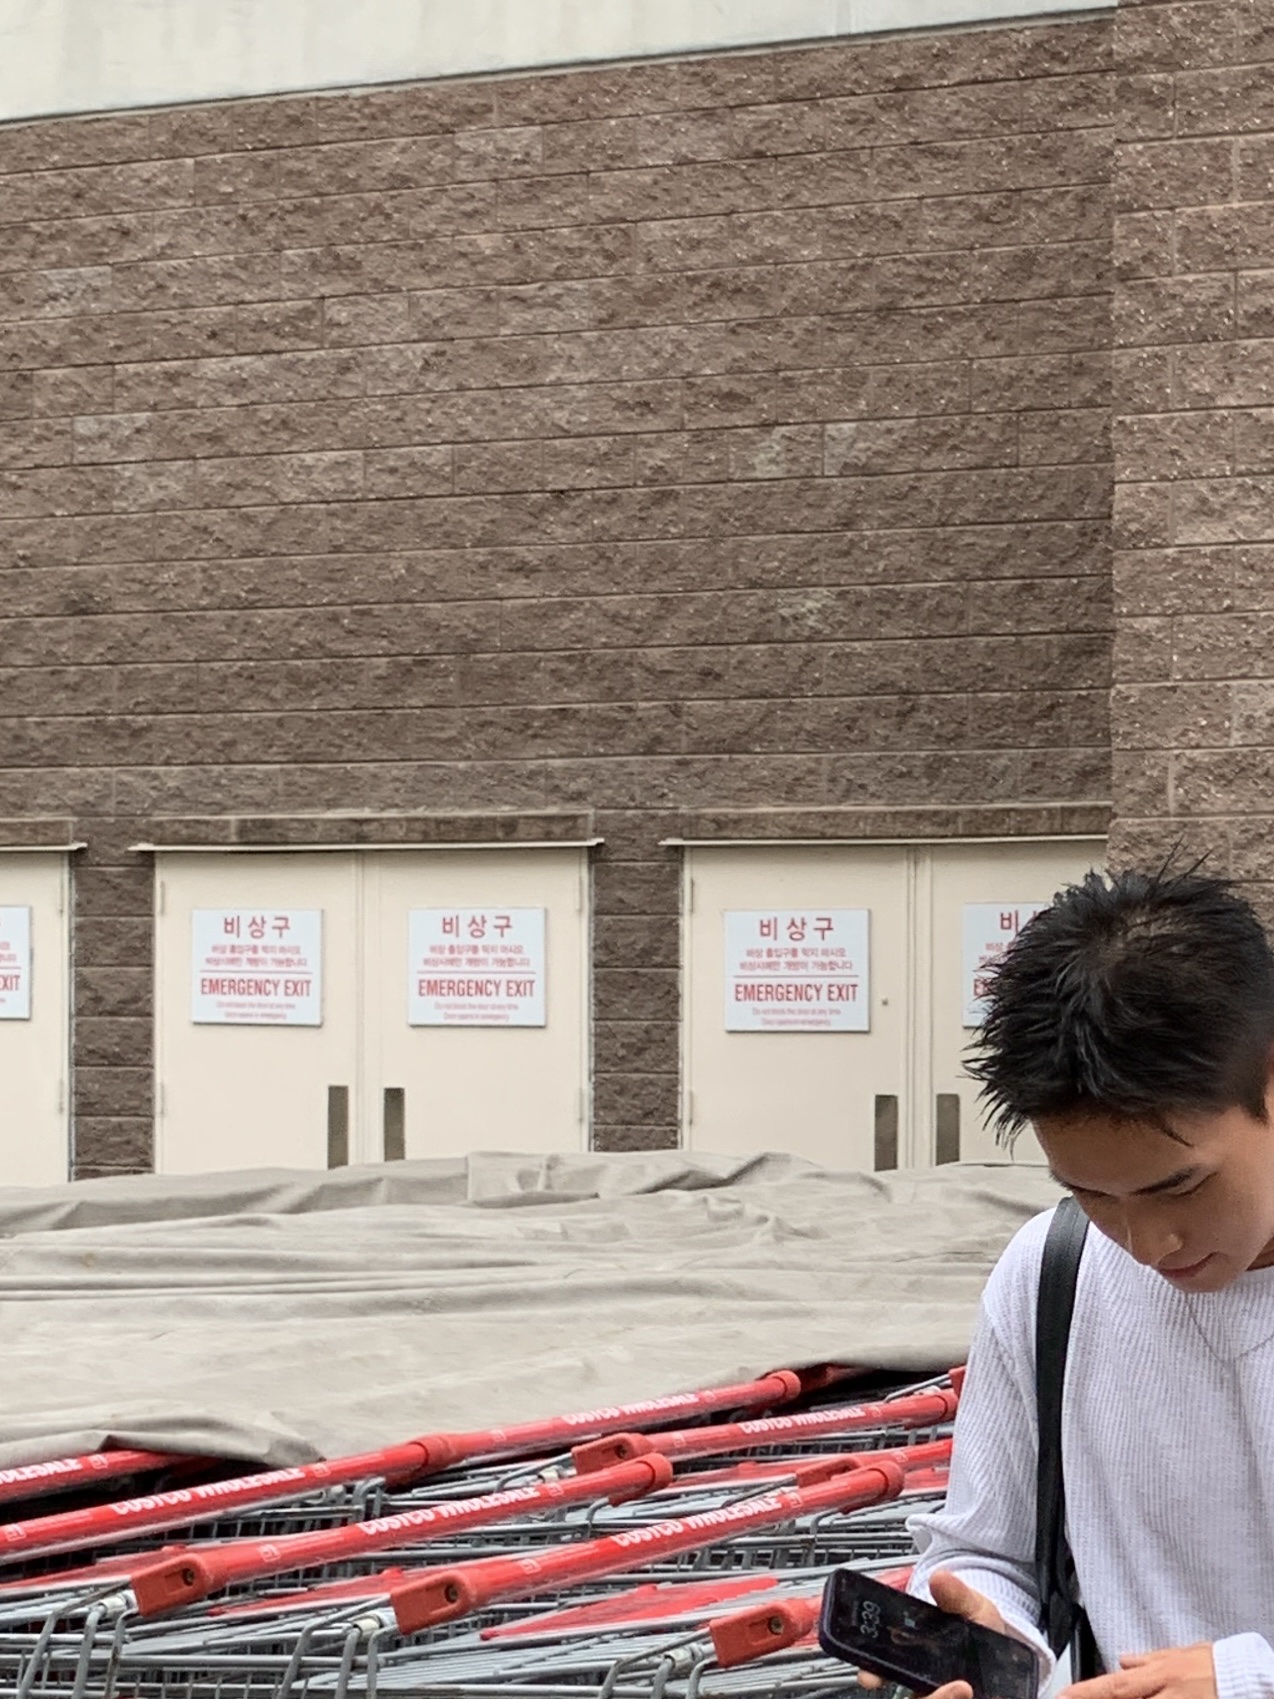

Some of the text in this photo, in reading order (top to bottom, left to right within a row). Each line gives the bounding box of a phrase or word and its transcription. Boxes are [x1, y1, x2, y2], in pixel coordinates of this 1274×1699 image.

[0, 974, 20, 991] XIT
[200, 978, 312, 997] EMERGENCY EXIT
[418, 979, 536, 997] EMERGENCY EXIT
[734, 983, 858, 1002] EMERGENCY EXIT
[561, 1392, 699, 1426] COSTCO WHOLESALE
[737, 1407, 866, 1434] COSTCO WHOLESALE
[108, 1467, 306, 1516] COSTCO WHOLESALE
[357, 1486, 542, 1535] COSTCO WHOLESALE
[610, 1495, 782, 1547] COSTCO WHOLESALE
[860, 1600, 881, 1639] 3:39
